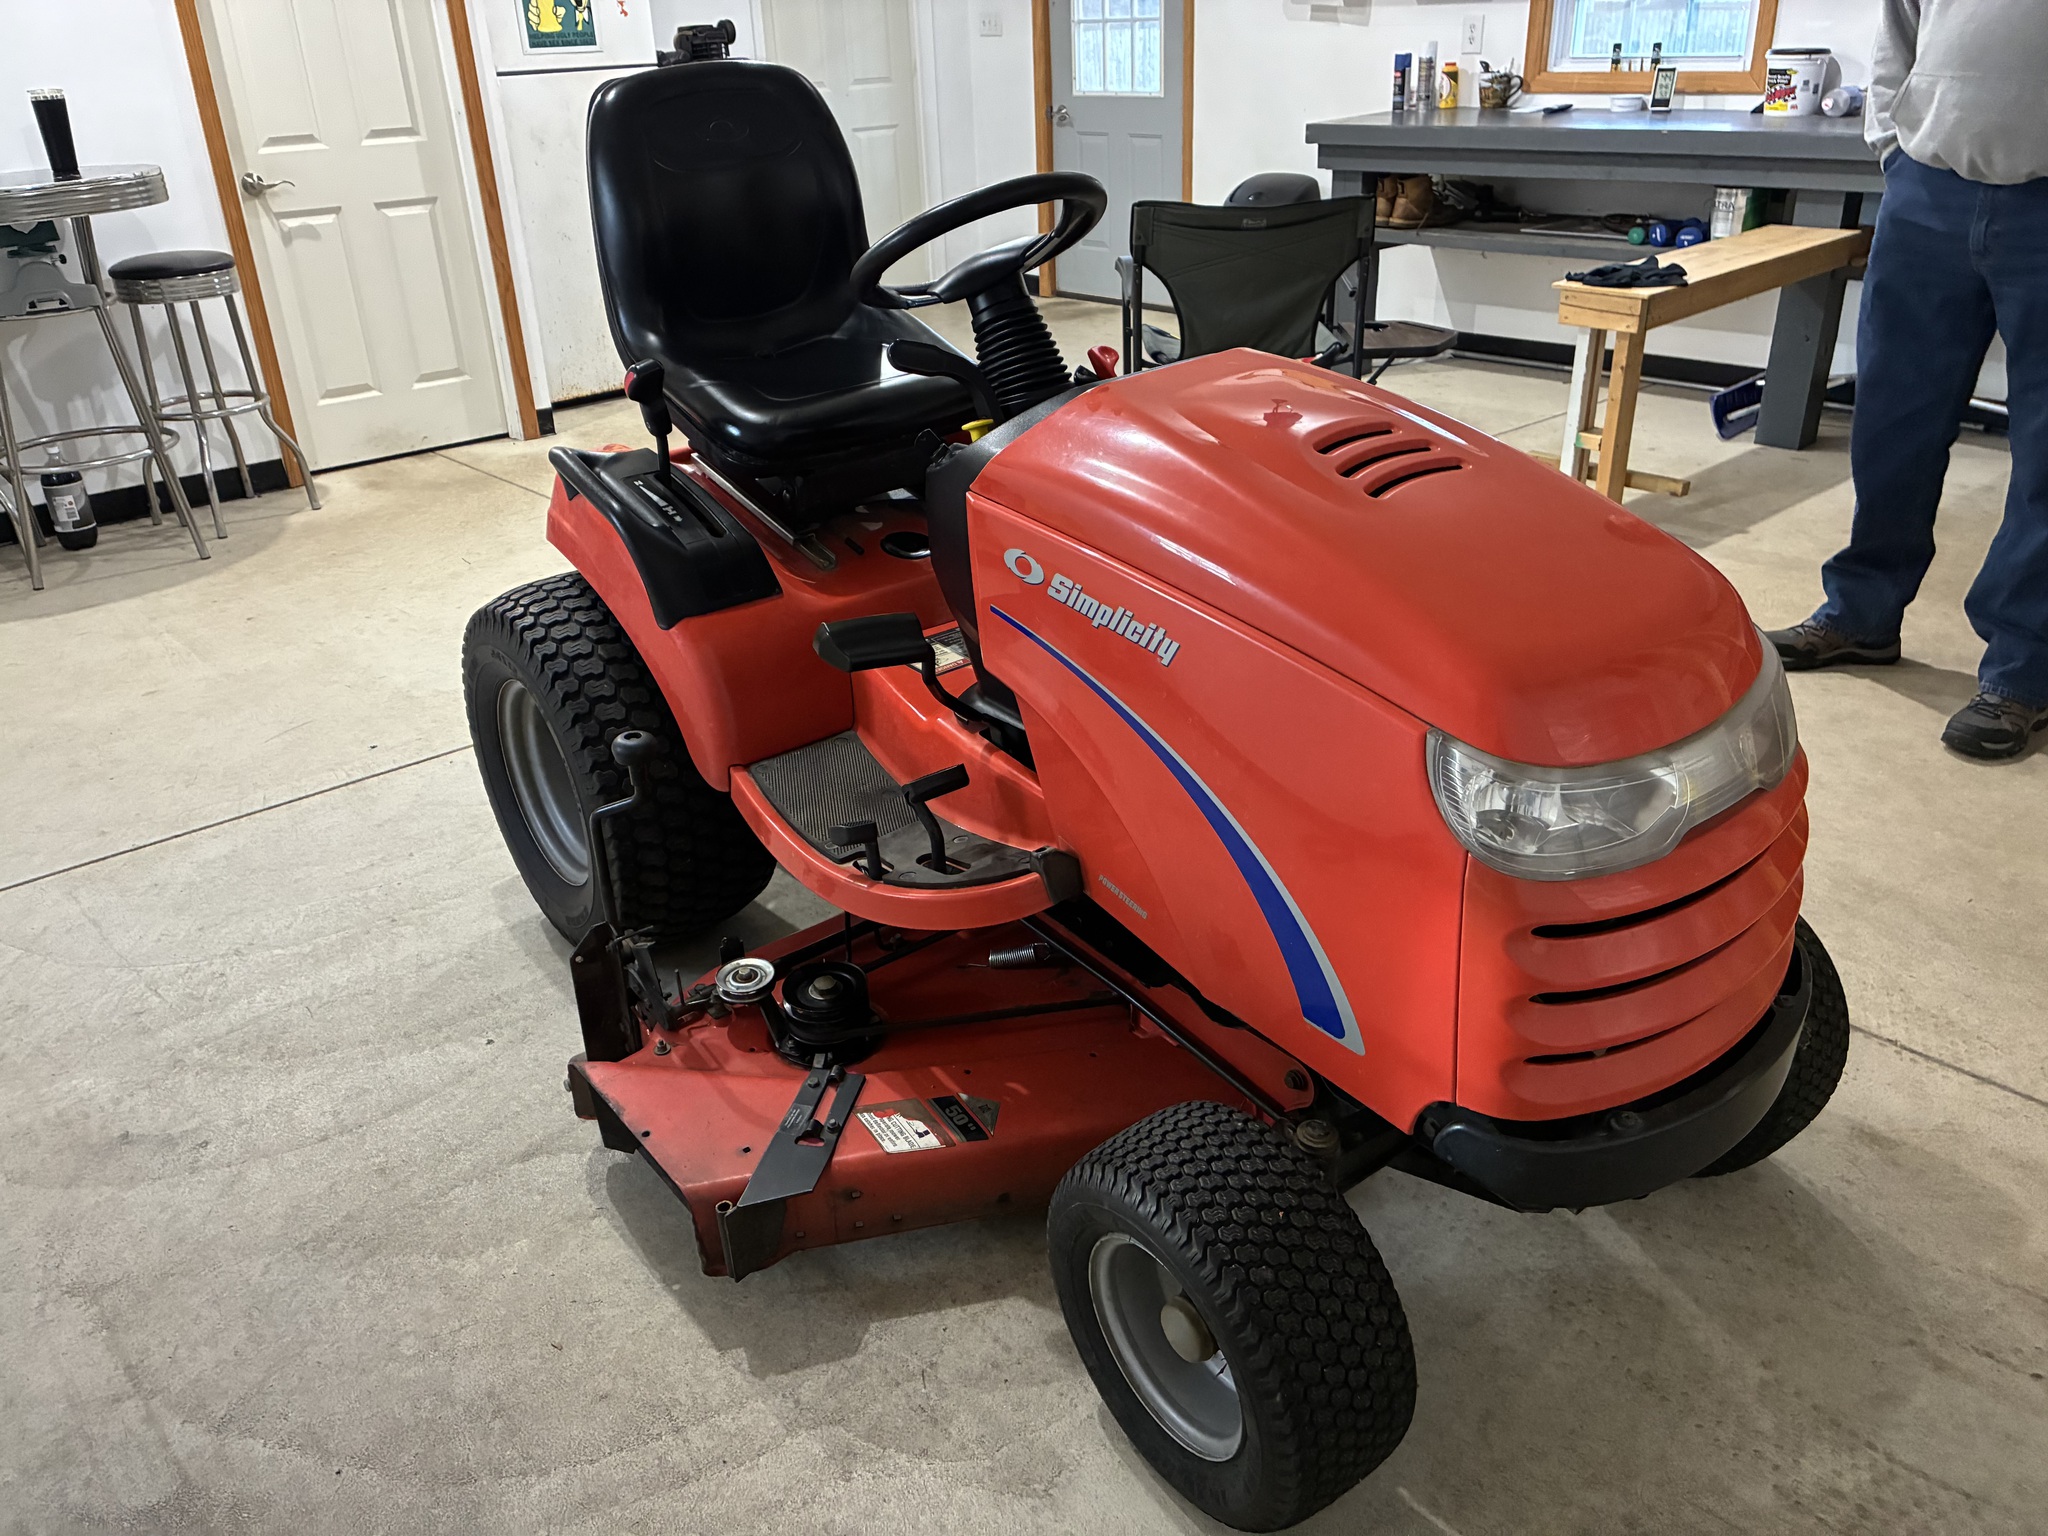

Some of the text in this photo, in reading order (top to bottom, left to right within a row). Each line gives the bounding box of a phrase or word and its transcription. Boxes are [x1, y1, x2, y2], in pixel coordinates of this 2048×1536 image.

[1047, 573, 1180, 667] Simplicity
[1098, 874, 1148, 920] POWER STEERING
[890, 1120, 907, 1137] CUTTING
[903, 1135, 917, 1150] BLADE
